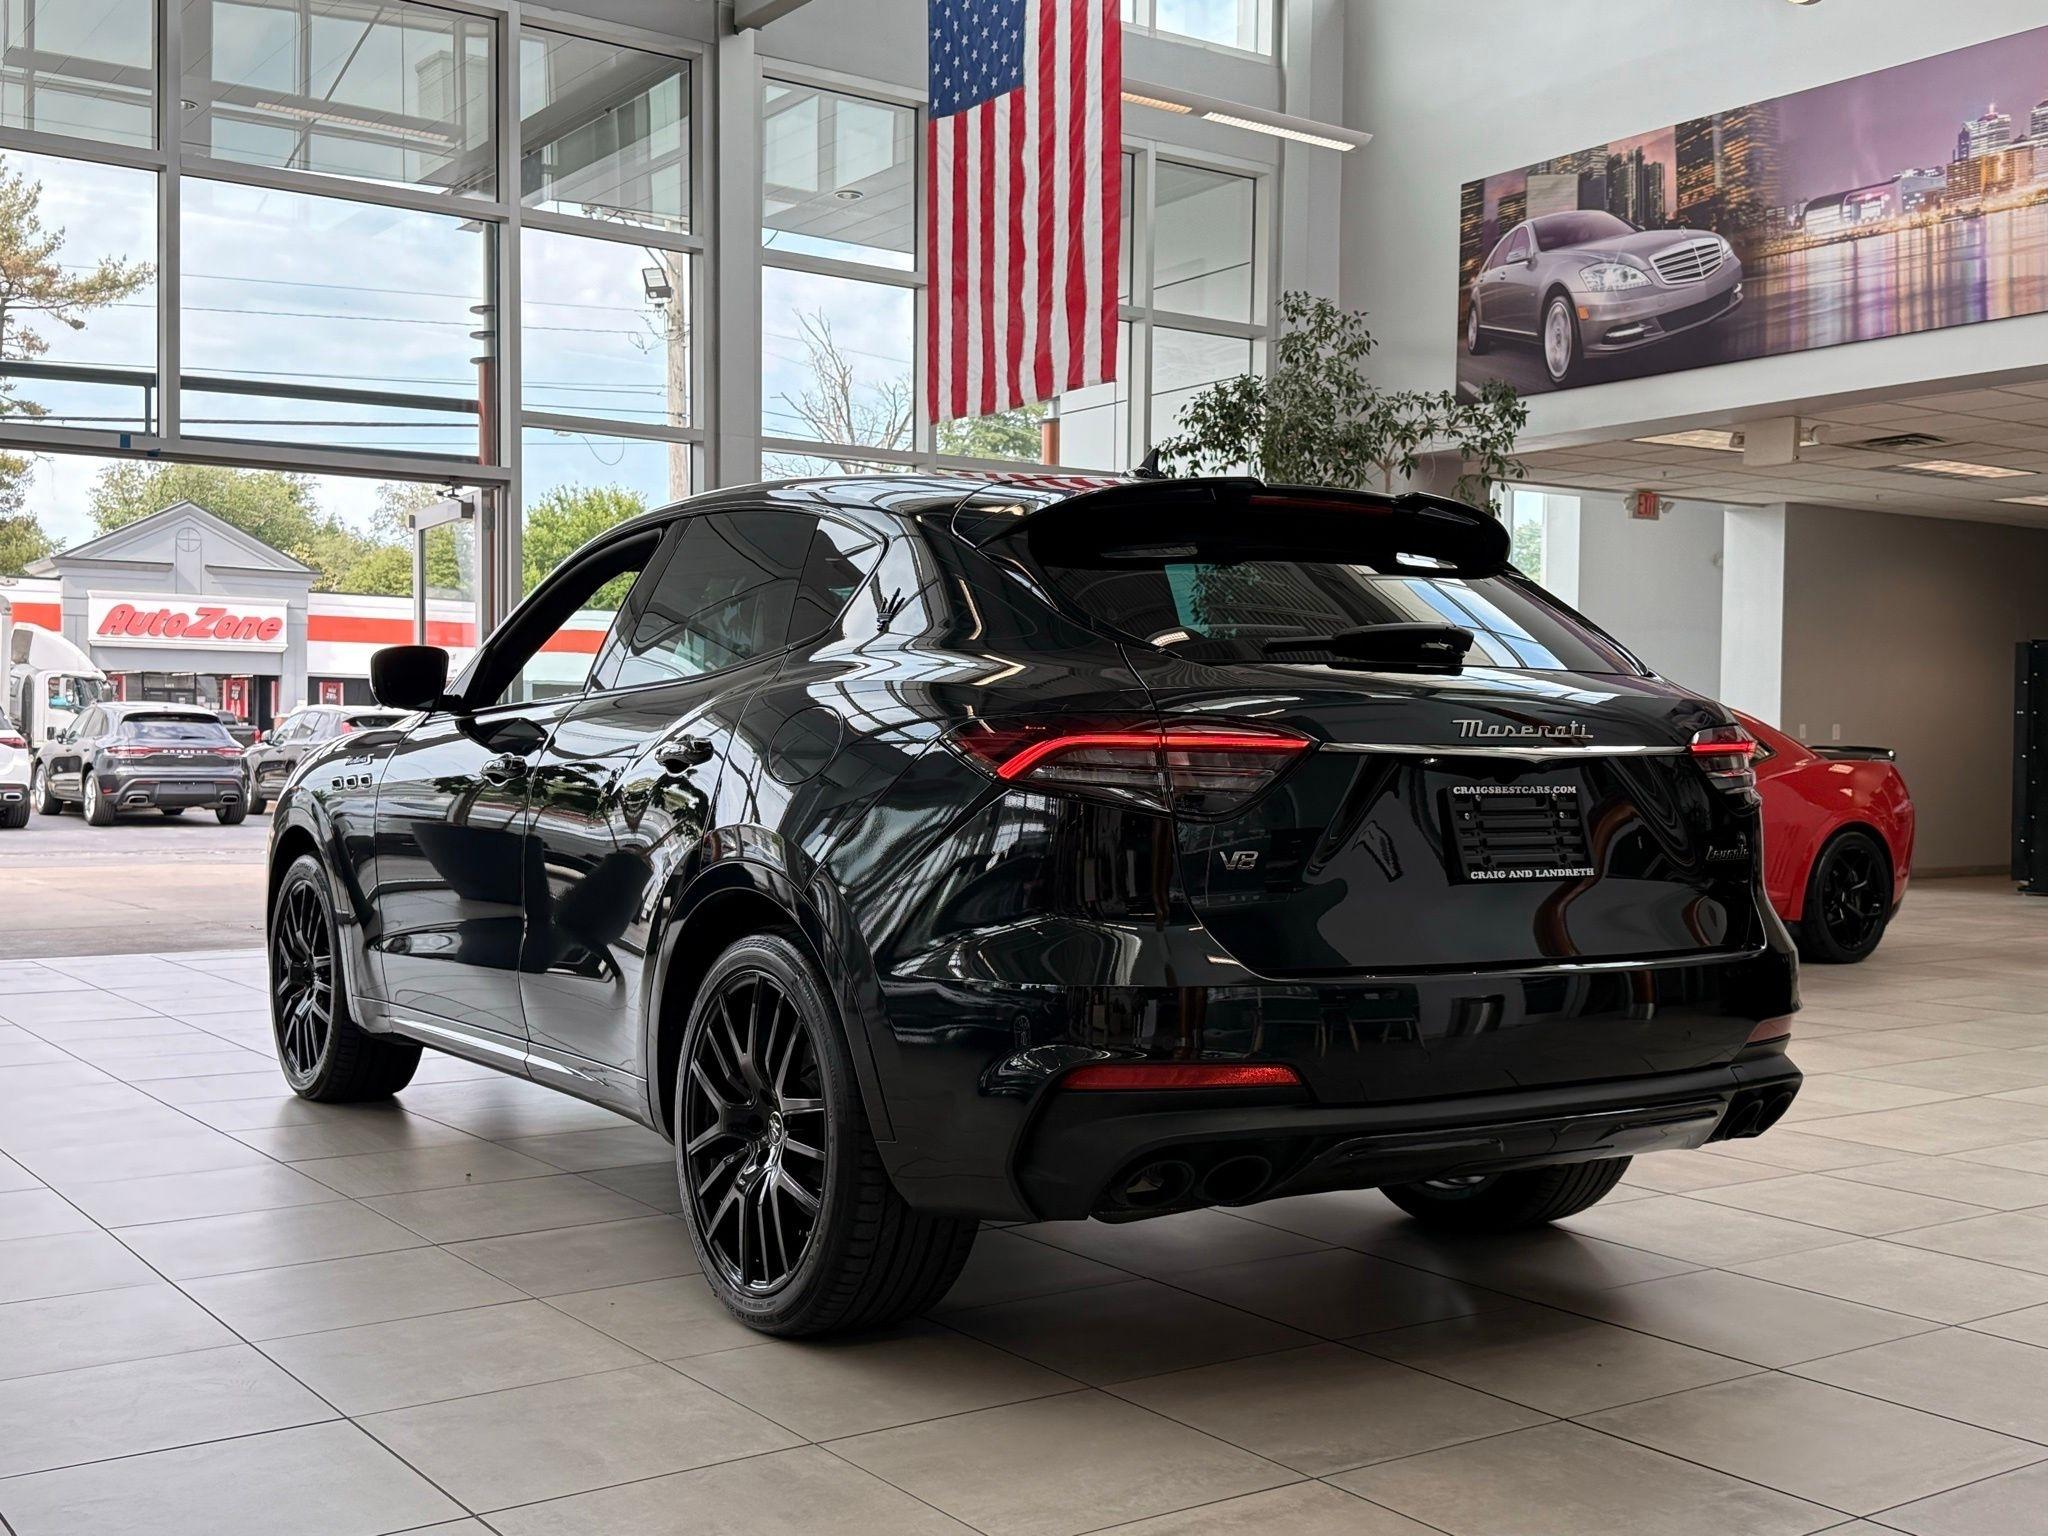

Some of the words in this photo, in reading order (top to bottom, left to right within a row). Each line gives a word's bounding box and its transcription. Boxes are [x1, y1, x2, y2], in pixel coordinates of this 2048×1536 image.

[97, 604, 283, 641] AutoZone
[1452, 719, 1594, 738] Maserati
[1453, 786, 1577, 794] CRAIGSBESTCARS.COM
[1219, 851, 1259, 870] V8
[1470, 870, 1506, 879] CRAIG
[1509, 869, 1533, 878] AND
[1535, 867, 1595, 878] LANDRETH
